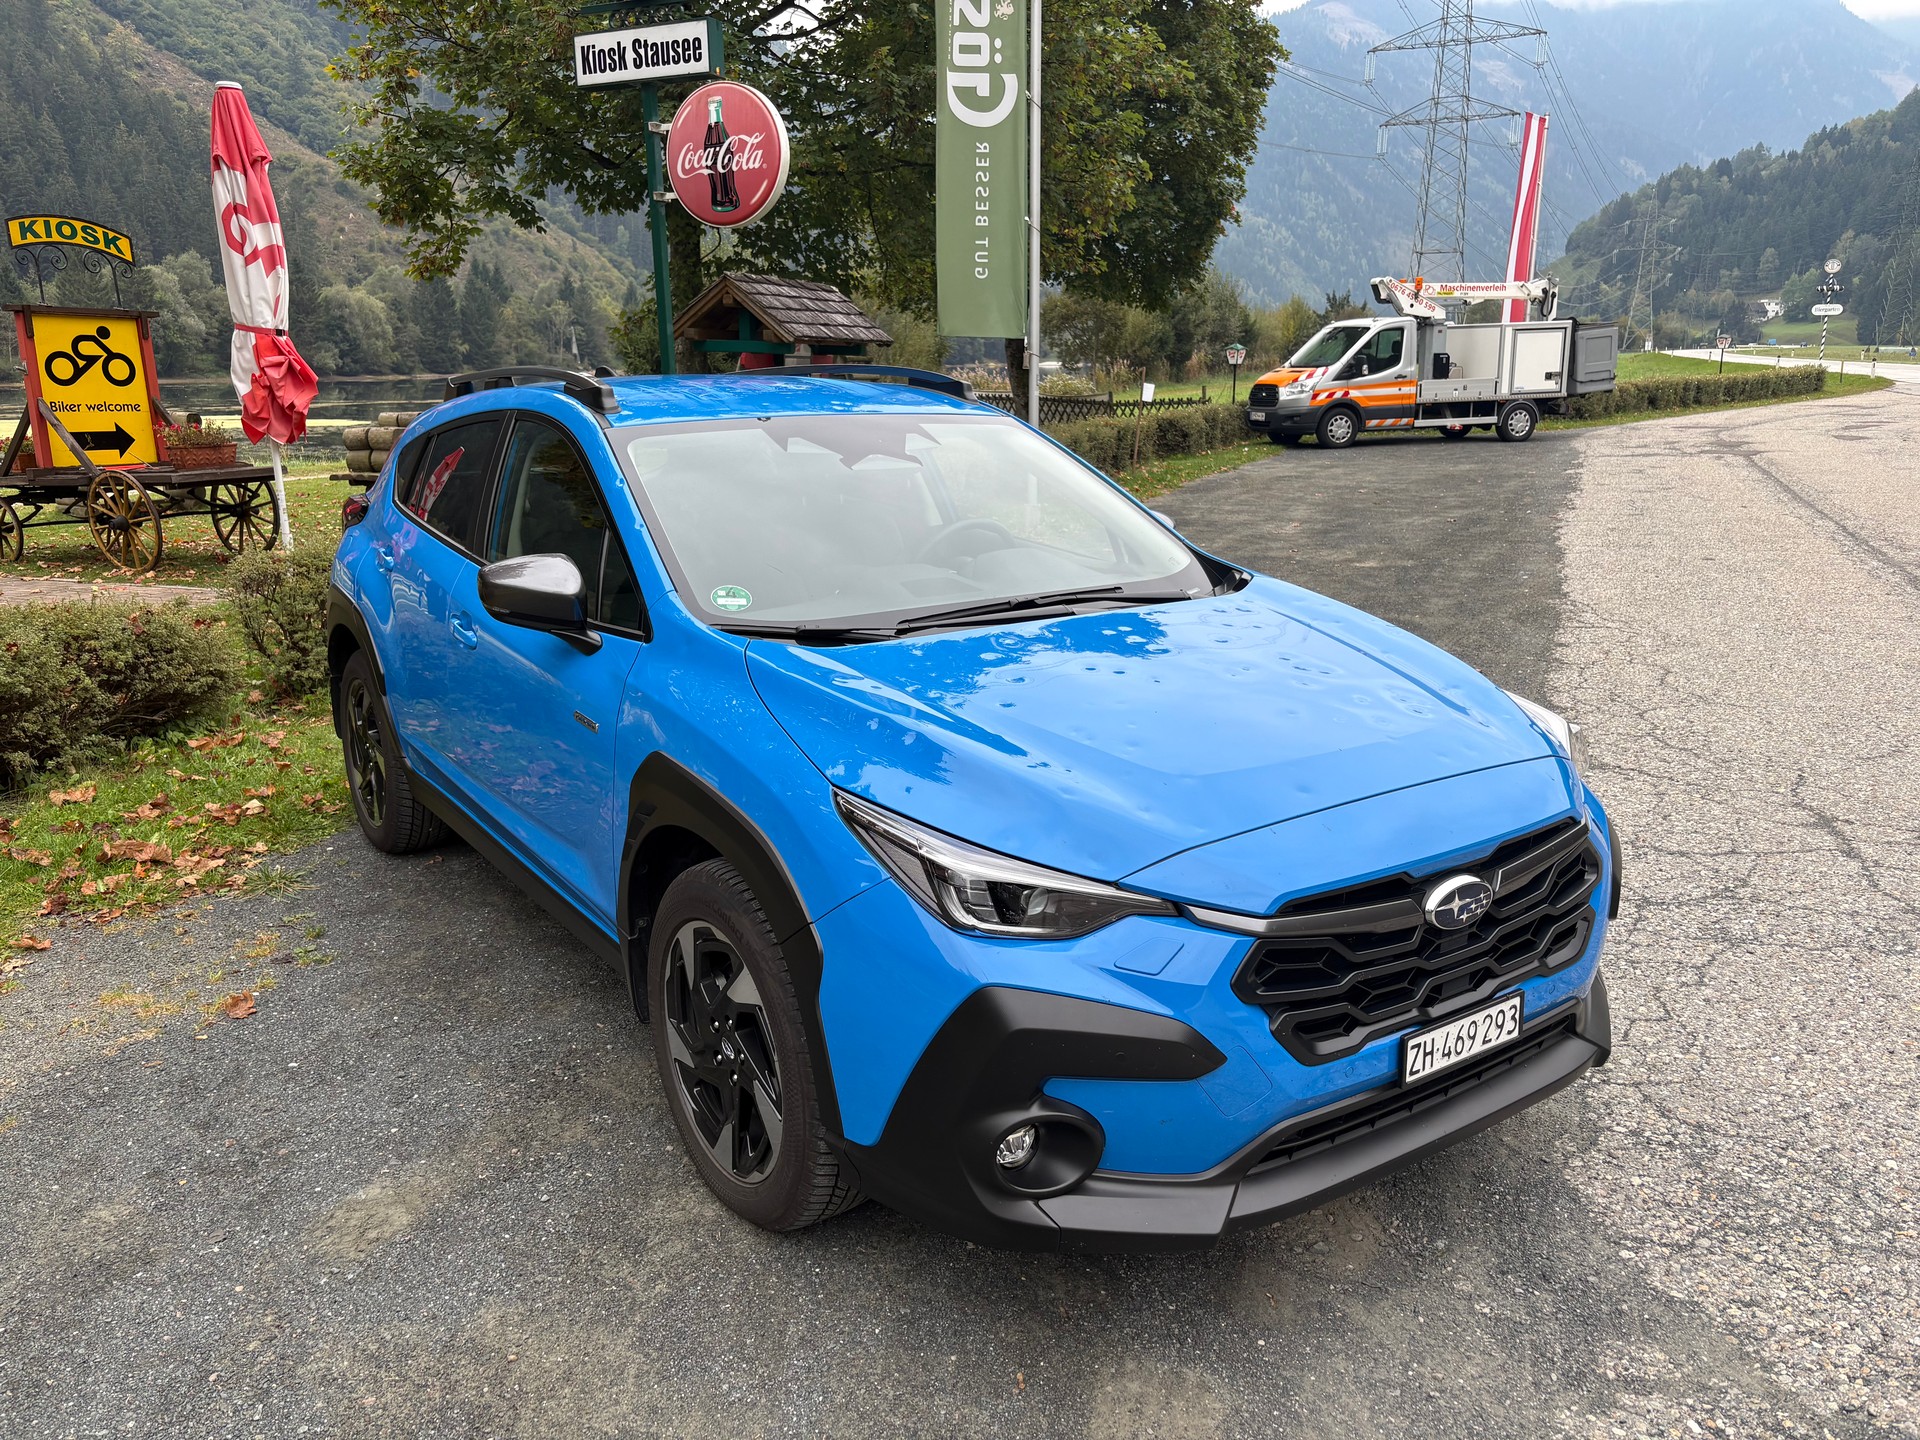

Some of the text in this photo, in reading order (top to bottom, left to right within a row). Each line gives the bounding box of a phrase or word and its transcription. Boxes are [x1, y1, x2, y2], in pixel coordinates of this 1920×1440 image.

[581, 36, 702, 75] Kiosk Stausee
[677, 132, 766, 179] Coca-Cola
[19, 219, 126, 257] KIOSK
[1390, 283, 1406, 295] 0676
[1424, 302, 1436, 312] 599
[1440, 284, 1507, 292] Maschinenverleih
[49, 401, 141, 413] Biker welcome
[1481, 1004, 1518, 1045] 293
